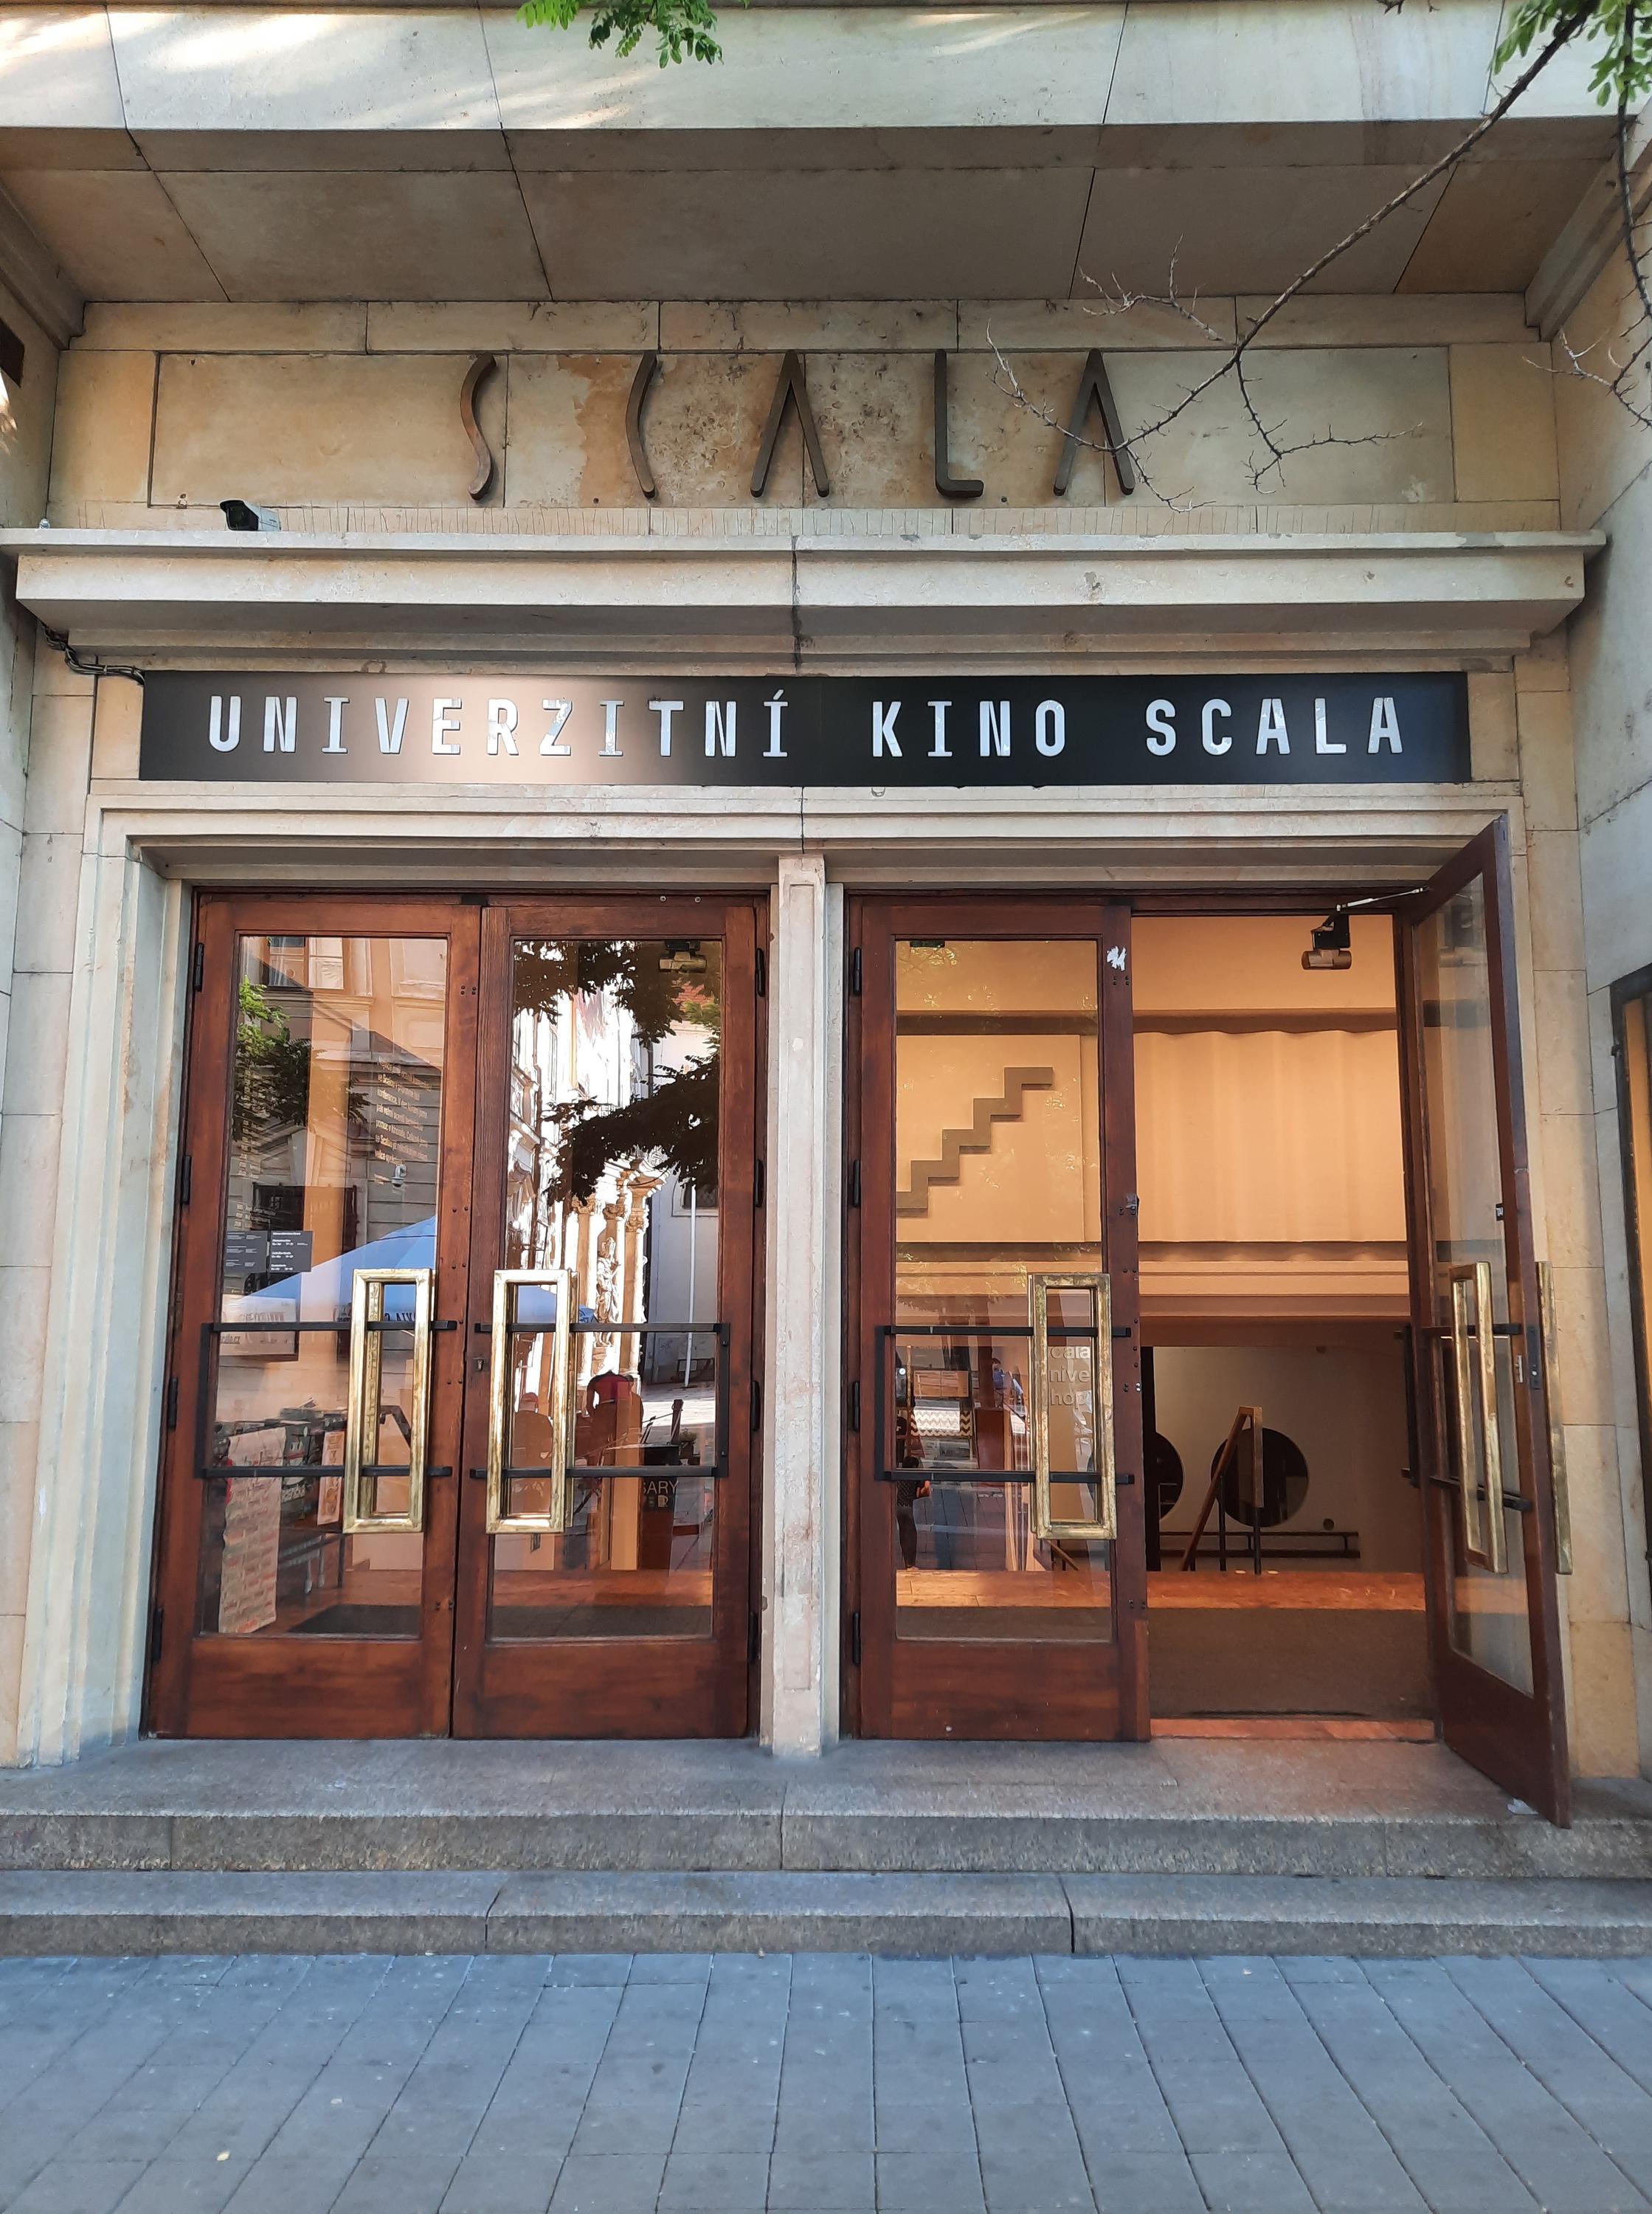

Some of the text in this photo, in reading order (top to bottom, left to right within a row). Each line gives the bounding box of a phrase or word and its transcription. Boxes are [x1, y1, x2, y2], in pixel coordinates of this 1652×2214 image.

[460, 350, 1136, 501] SCALA
[208, 689, 1404, 759] UNIVERZITNÍ KINO SCALA
[1051, 1347, 1090, 1359] cala
[1049, 1366, 1090, 1383] nive
[1050, 1387, 1087, 1409] hop
